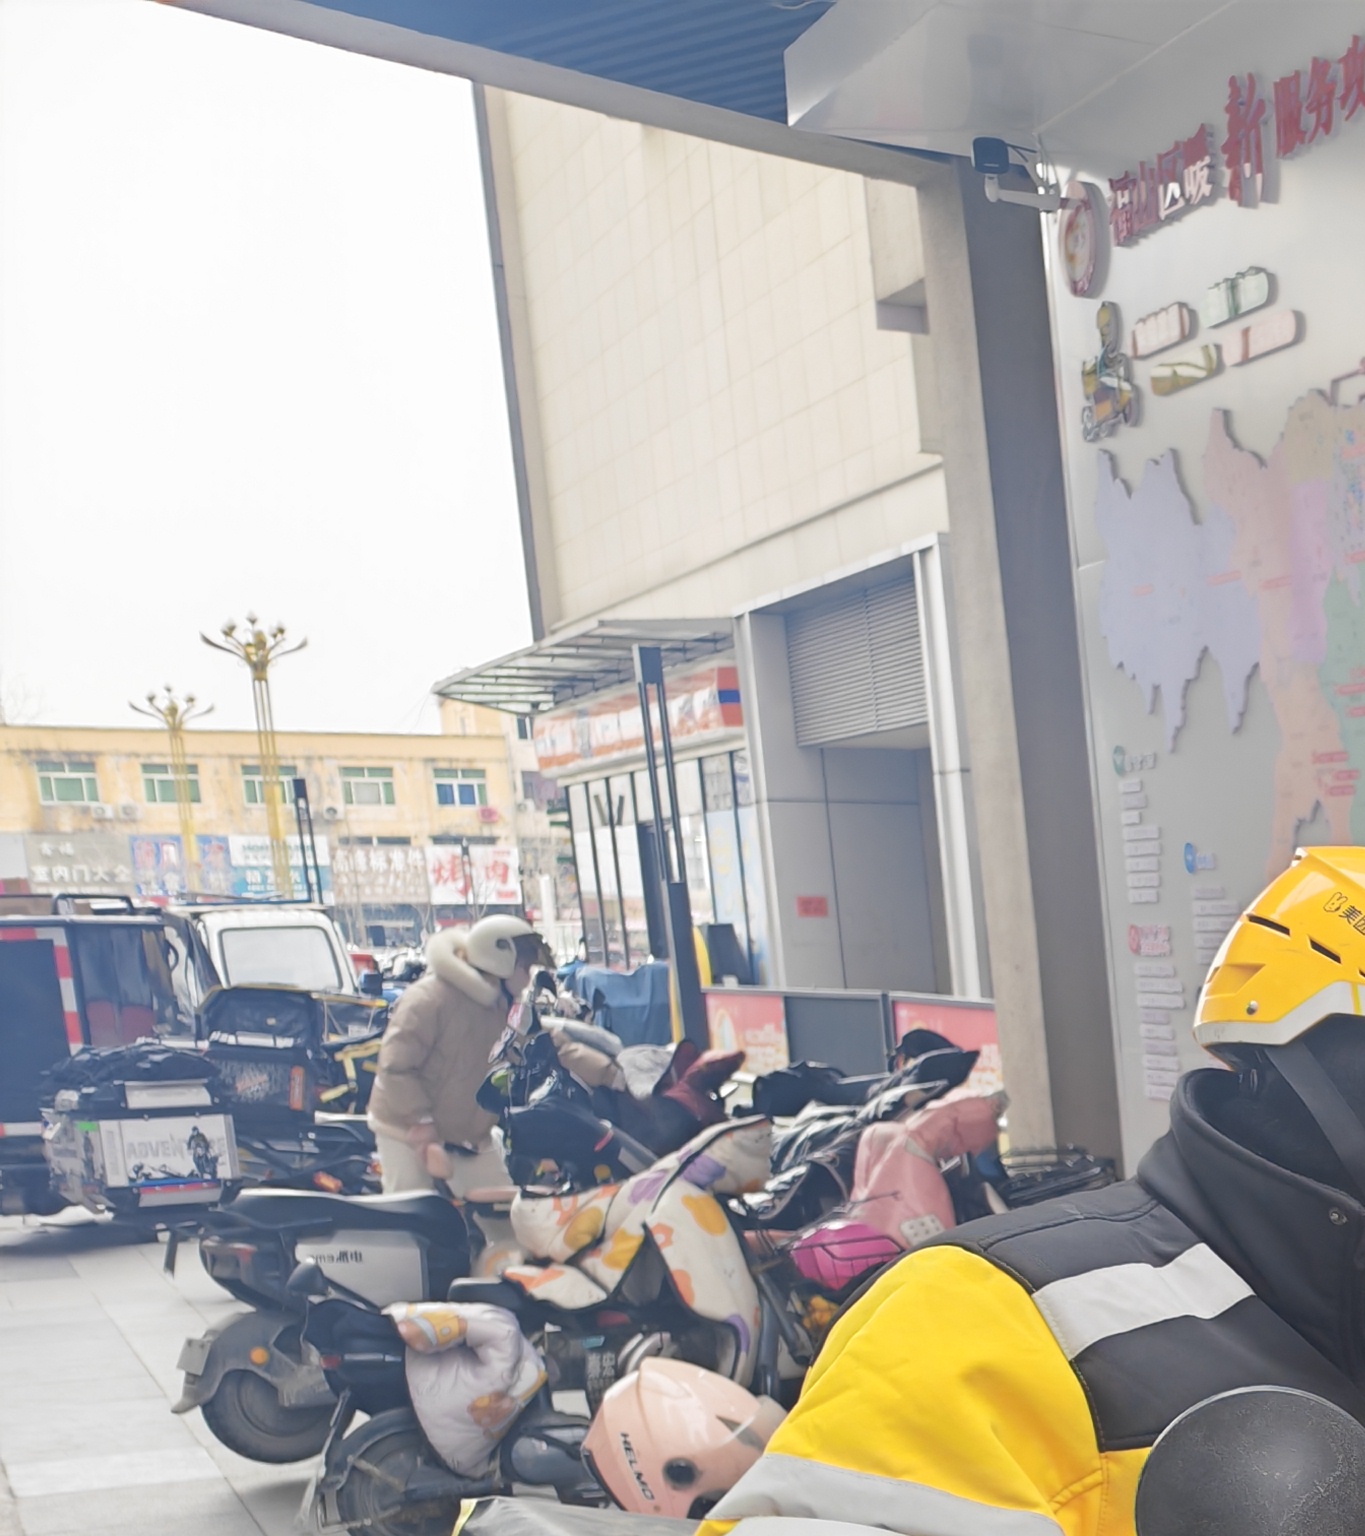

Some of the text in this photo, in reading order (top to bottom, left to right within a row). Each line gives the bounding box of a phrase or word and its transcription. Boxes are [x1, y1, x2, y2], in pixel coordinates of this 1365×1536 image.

[30, 864, 132, 883] 室内门大全
[620, 1432, 655, 1501] HELMO
